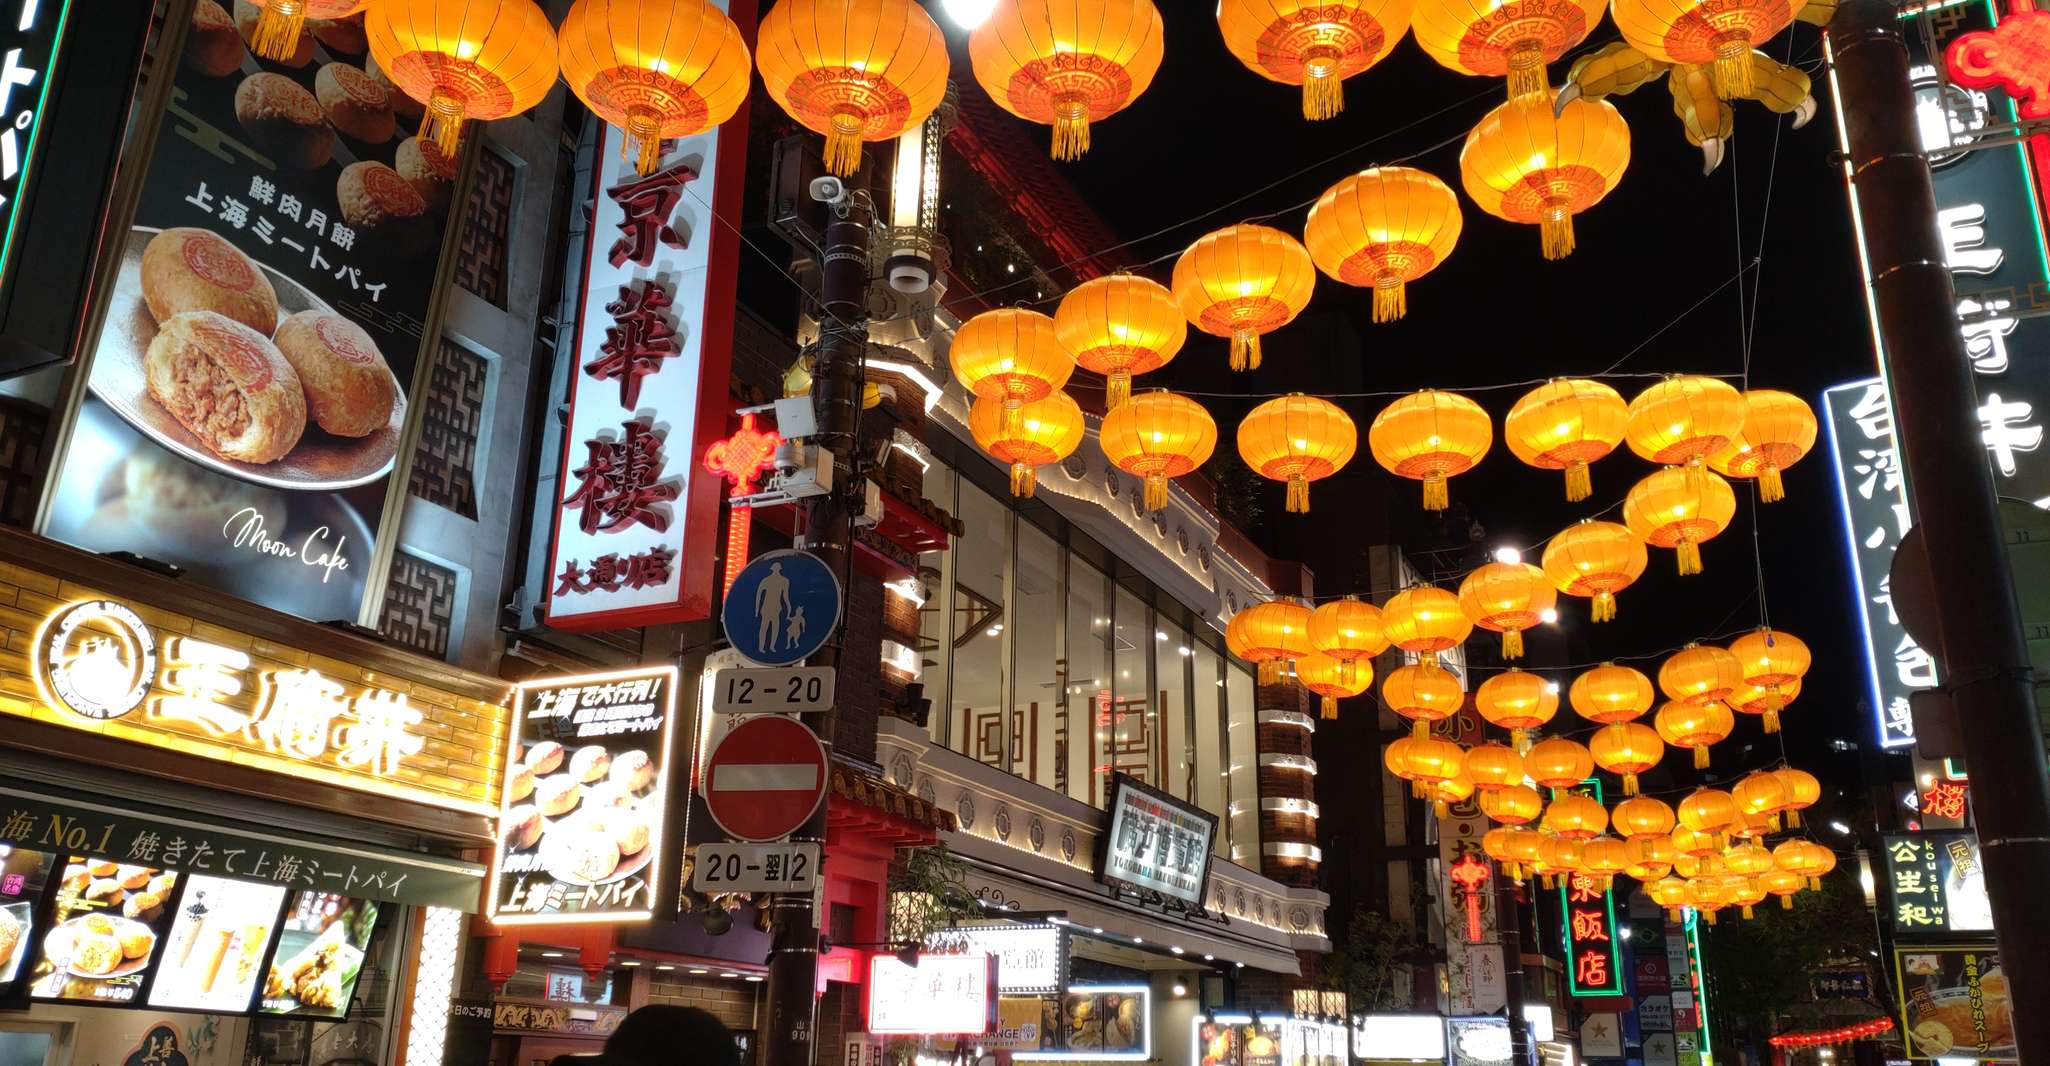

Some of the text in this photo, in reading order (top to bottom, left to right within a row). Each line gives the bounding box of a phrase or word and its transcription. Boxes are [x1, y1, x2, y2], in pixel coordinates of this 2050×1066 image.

[185, 181, 388, 303] 上海ミートパイ
[249, 175, 355, 252] 鮮肉月餅
[223, 507, 349, 583] Moon Cake
[553, 547, 677, 597] 大通り店
[727, 676, 821, 704] 12-20
[40, 813, 117, 855] No.1
[127, 829, 409, 898] 焼きたて上海ミートパイ
[1889, 840, 1933, 927] 公生和
